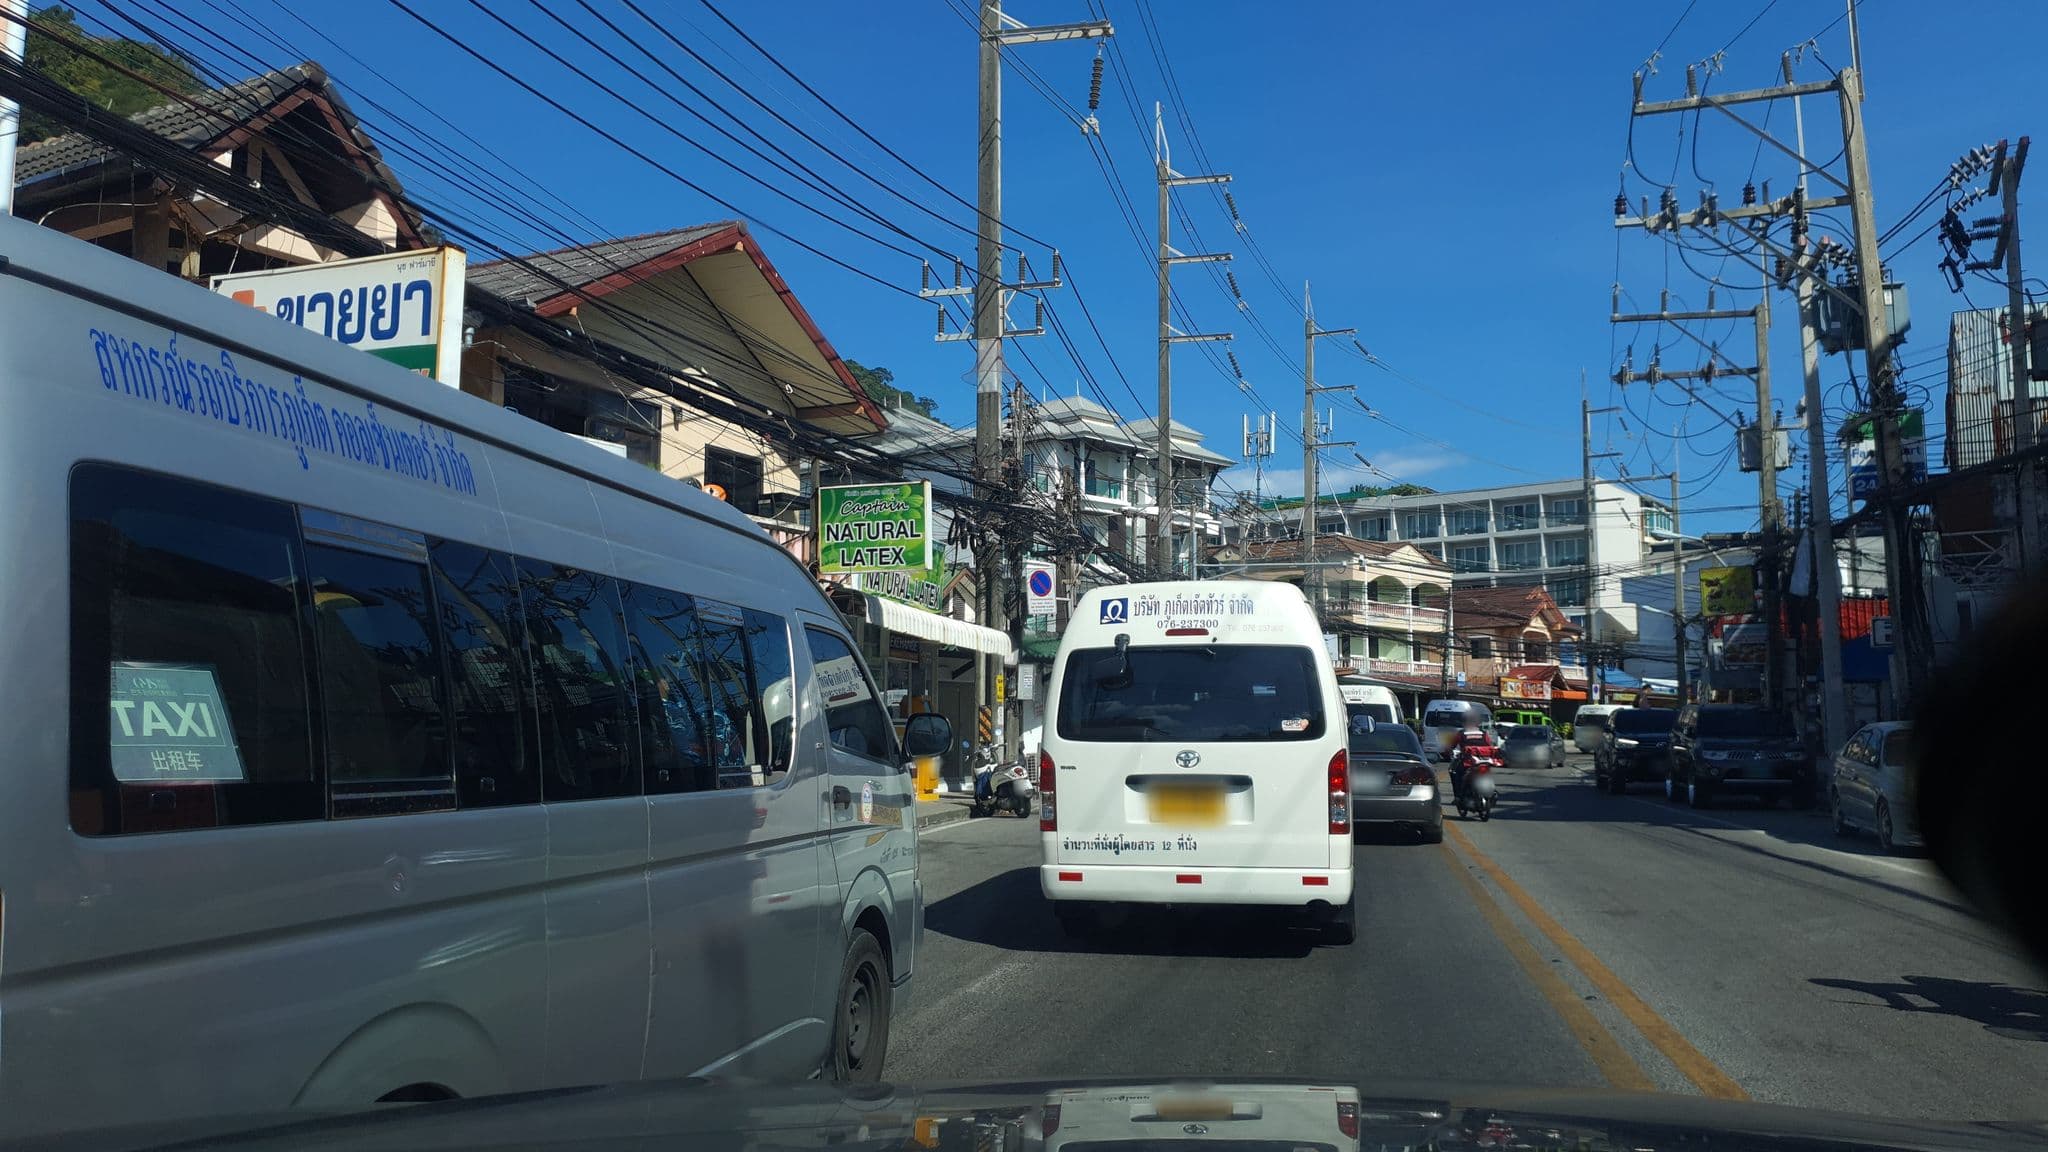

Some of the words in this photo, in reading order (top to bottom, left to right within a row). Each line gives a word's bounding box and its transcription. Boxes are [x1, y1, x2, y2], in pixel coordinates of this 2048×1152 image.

[840, 497, 909, 519] Captain
[825, 520, 922, 543] NATURAL
[840, 547, 905, 568] LATEX
[865, 571, 911, 601] NATURAL
[913, 579, 940, 610] LATEX
[1156, 619, 1219, 630] 076-237300
[111, 700, 217, 738] TAXI
[151, 750, 203, 772] 出租车
[1161, 839, 1173, 851] 12
